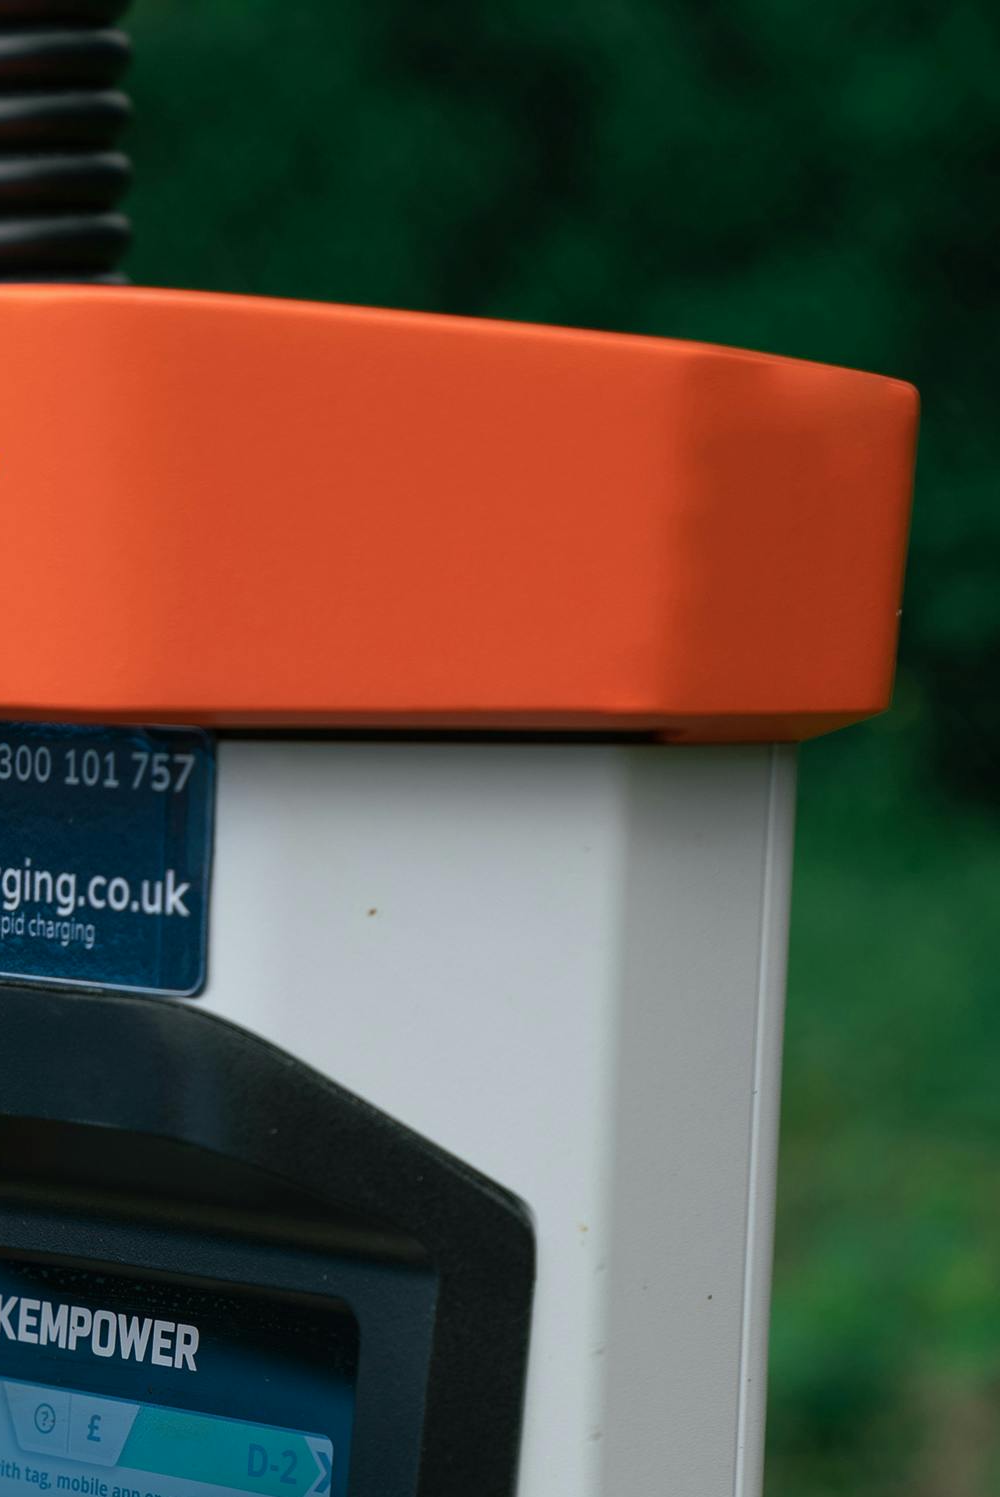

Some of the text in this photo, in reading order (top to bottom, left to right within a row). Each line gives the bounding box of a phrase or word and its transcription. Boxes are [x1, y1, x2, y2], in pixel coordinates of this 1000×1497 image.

[64, 748, 120, 789] 101
[130, 752, 196, 793] 757
[28, 913, 96, 950] charging
[25, 1466, 53, 1491] tag,
[247, 1442, 299, 1486] D-2
